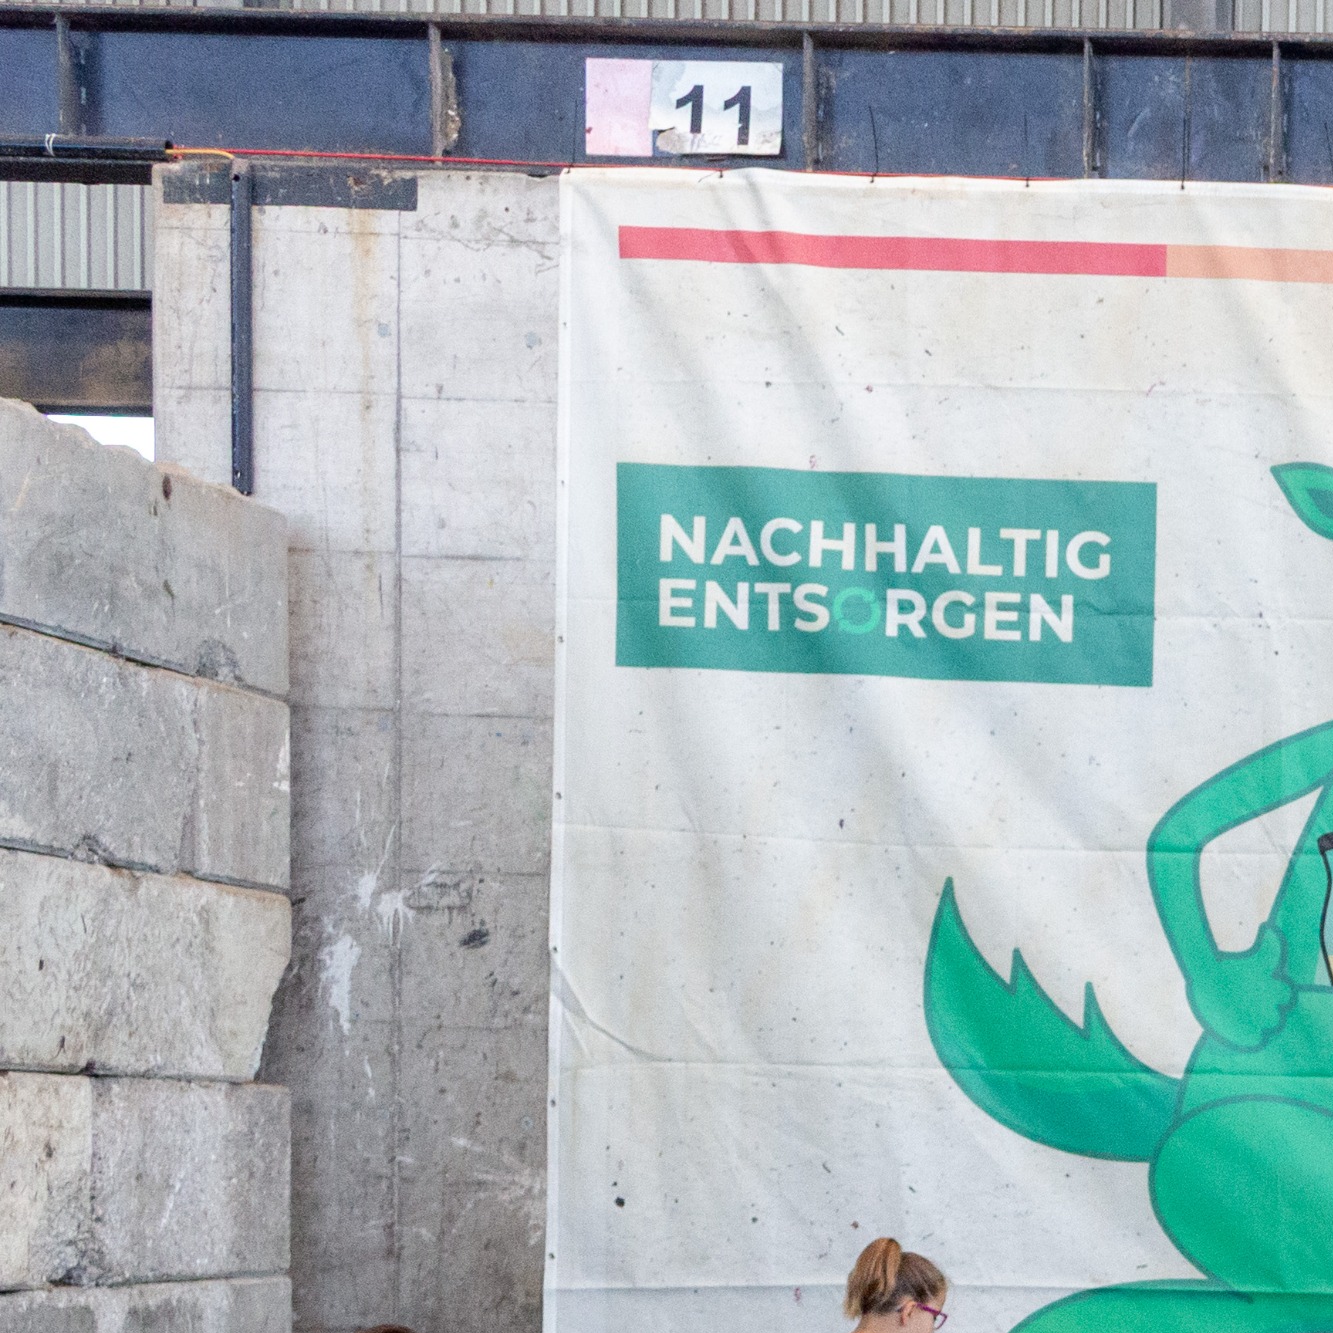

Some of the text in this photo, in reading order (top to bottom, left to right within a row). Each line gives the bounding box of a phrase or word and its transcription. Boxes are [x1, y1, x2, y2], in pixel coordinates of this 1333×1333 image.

[675, 84, 751, 146] 11
[658, 513, 1112, 580] NACHHALTIG
[658, 577, 1074, 643] ENTSORGEN
